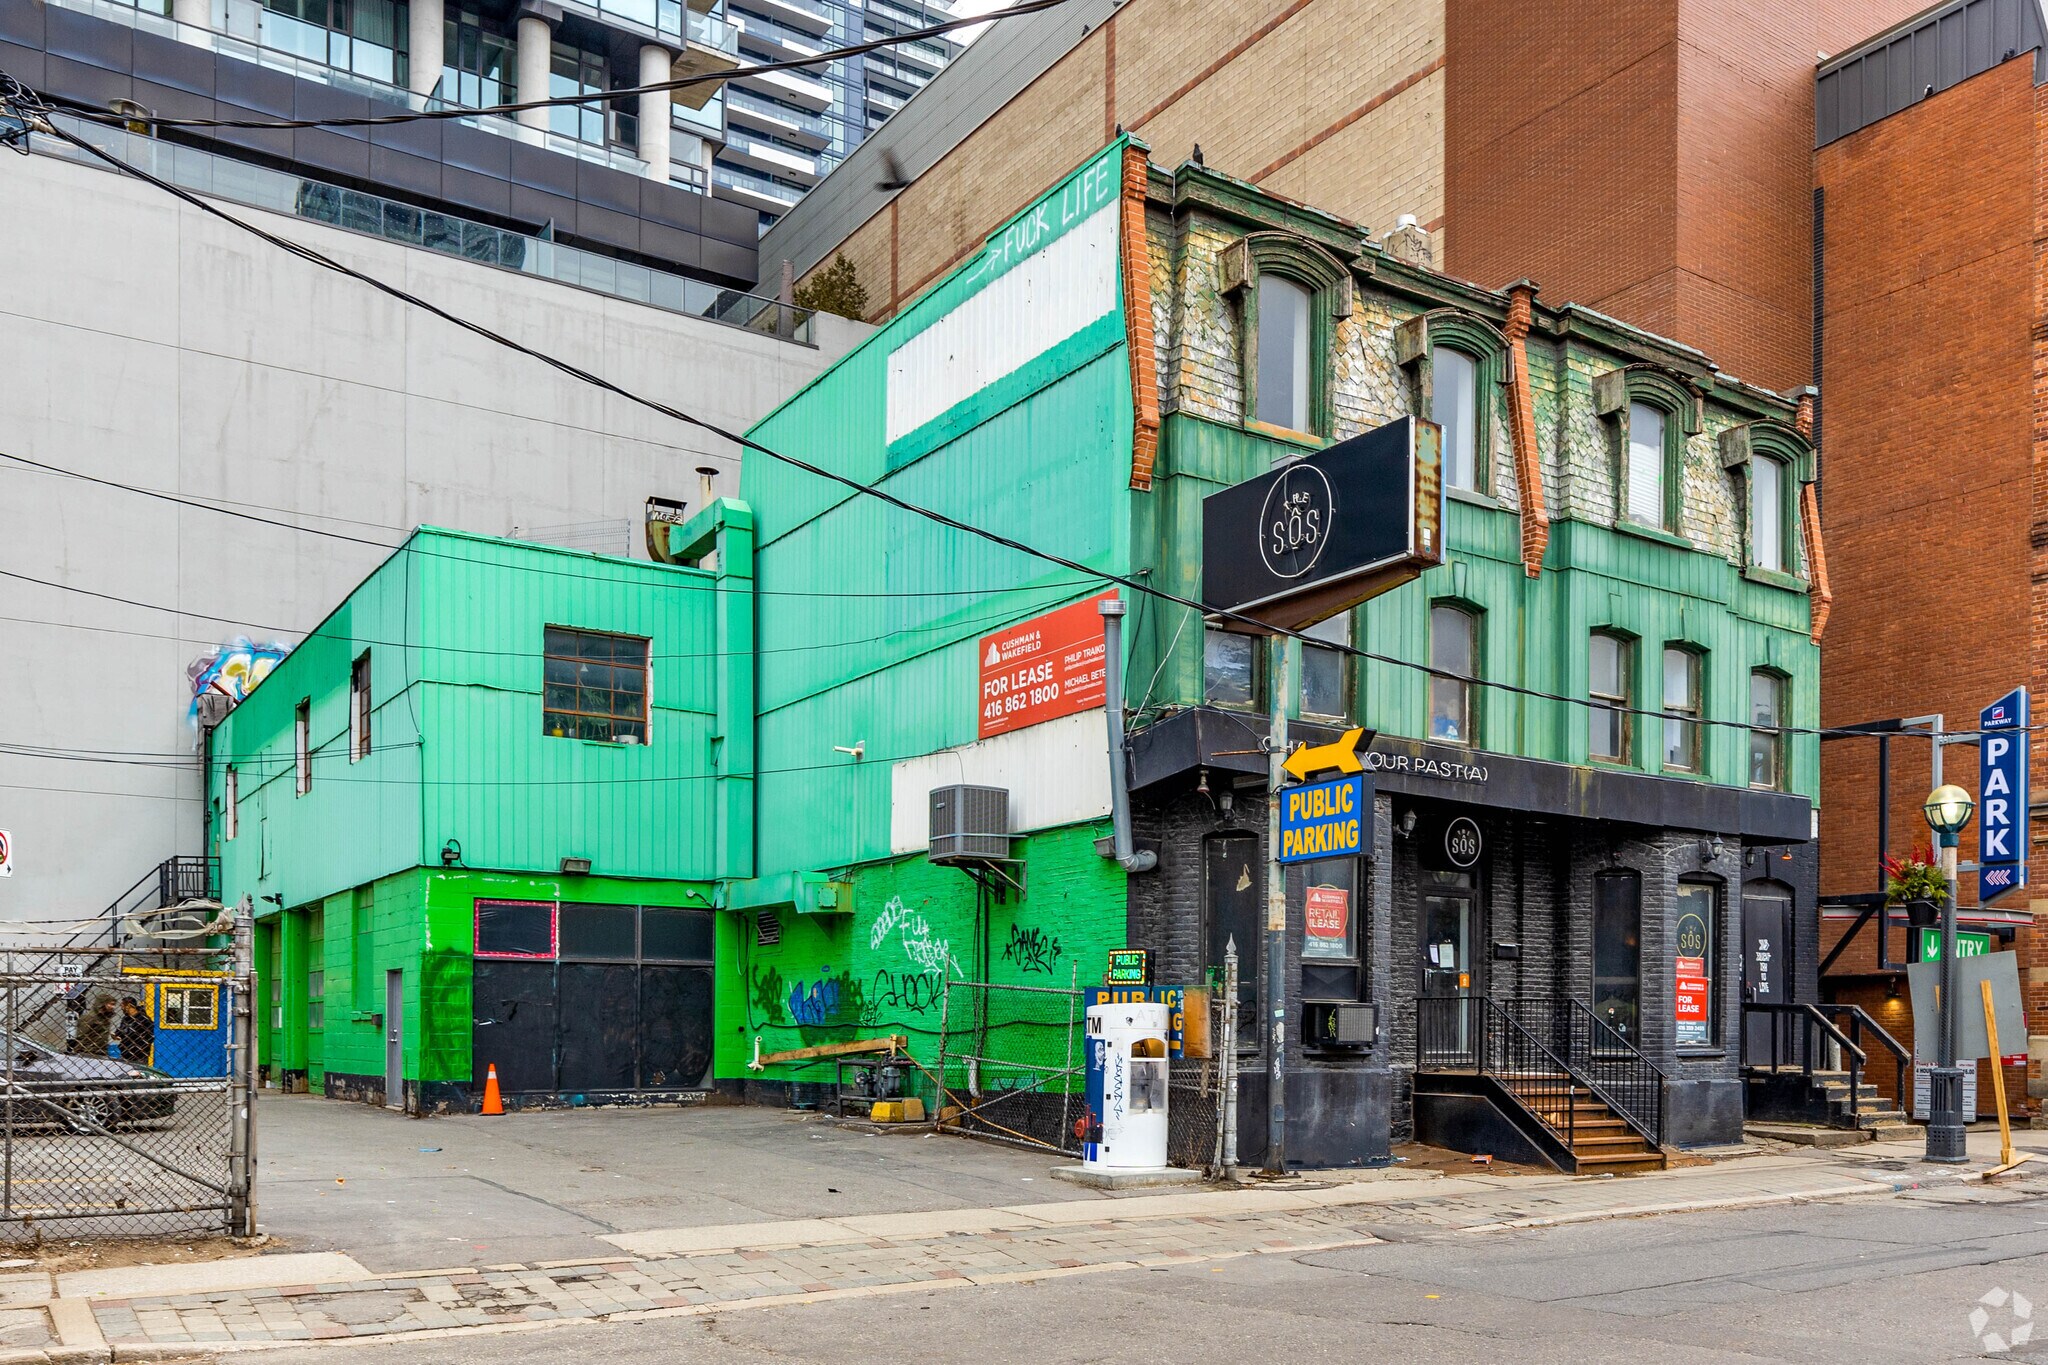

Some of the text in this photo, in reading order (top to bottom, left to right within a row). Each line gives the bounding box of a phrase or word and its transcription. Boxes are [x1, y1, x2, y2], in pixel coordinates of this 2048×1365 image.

[1004, 157, 1108, 262] FUCK LIFE
[1001, 630, 1041, 651] CUSHMAN &
[1001, 641, 1042, 661] WAKEFIELD
[1064, 651, 1082, 665] PHILIP
[984, 675, 1008, 699] FOR
[1011, 661, 1054, 691] LEASE
[1064, 673, 1090, 690] MICHAEL
[984, 699, 1002, 719] 416
[1005, 693, 1027, 713] 862
[1029, 683, 1059, 706] 1800
[1984, 717, 2012, 727] PARKWAY
[1366, 751, 1489, 782] OUR PAST(A)
[1289, 782, 1354, 822] PUBLIC
[1984, 737, 2011, 857] PARK
[1283, 819, 1359, 857] PARKING
[1956, 939, 1983, 958] NTRY
[1115, 954, 1139, 965] PUBLIC
[1112, 968, 1141, 980] PARKING
[1097, 989, 1177, 1008] PUBIC
[1678, 996, 1692, 1004] FOR
[1678, 1005, 1699, 1013] LEASE
